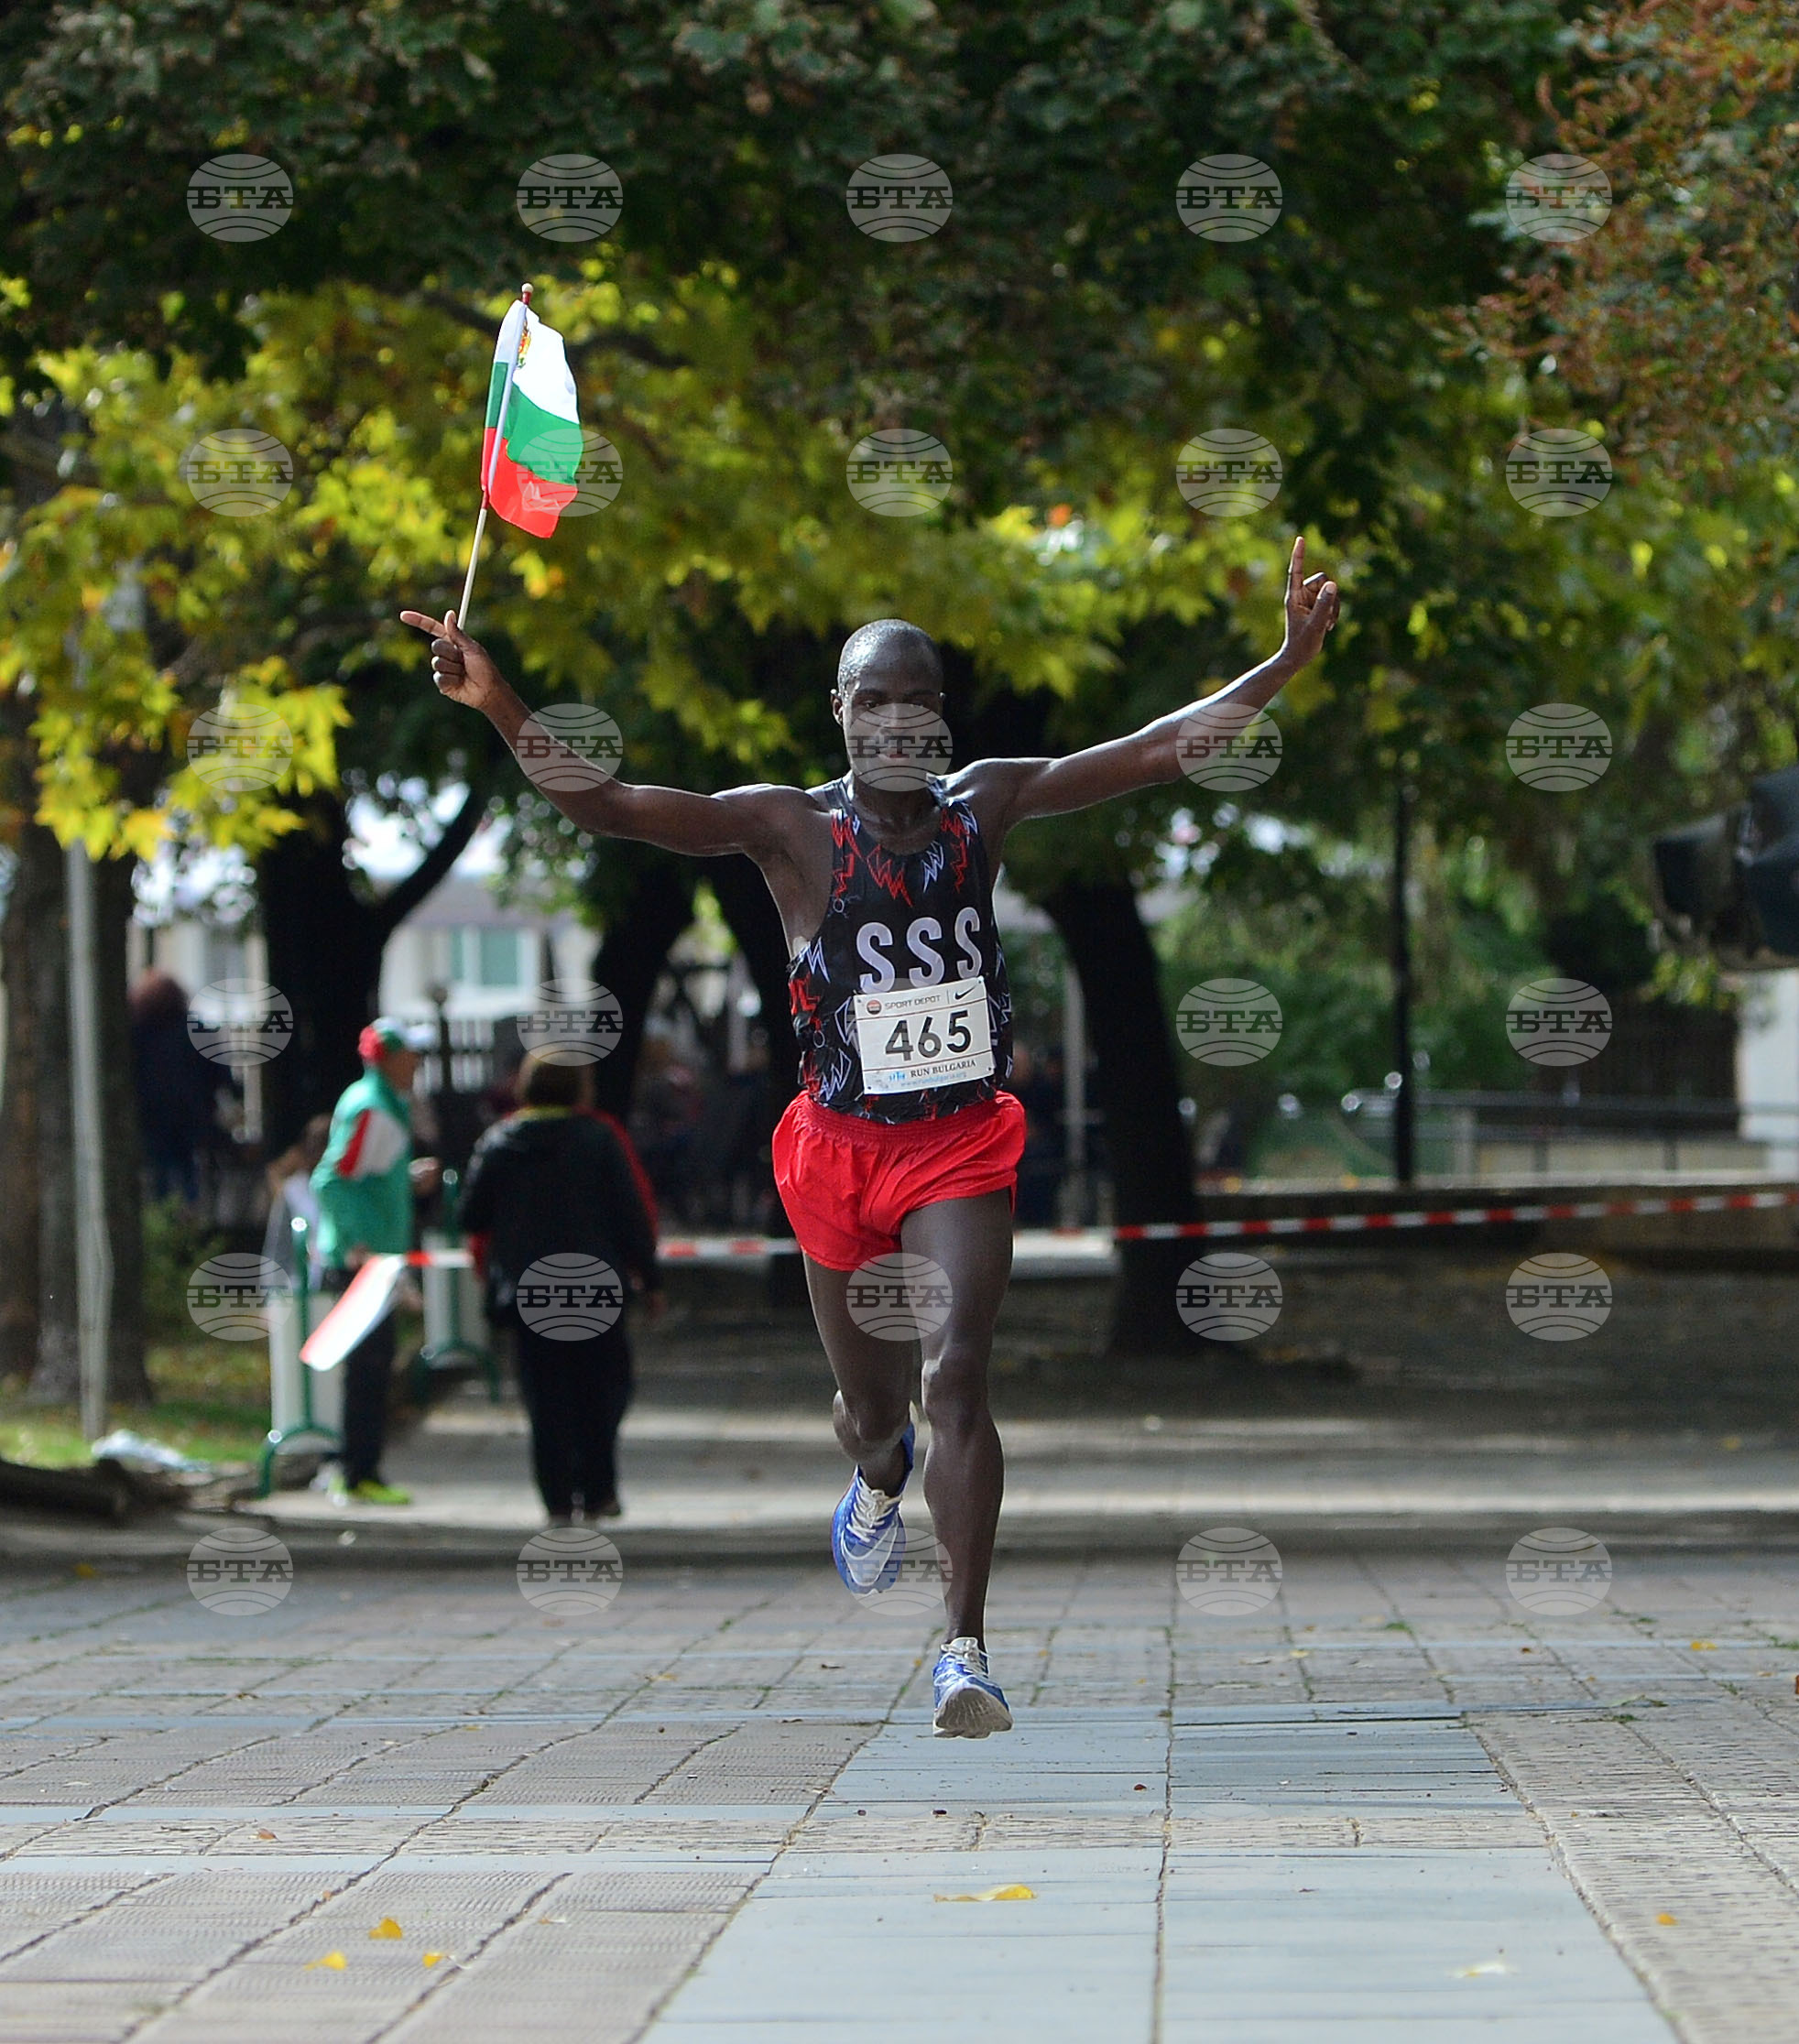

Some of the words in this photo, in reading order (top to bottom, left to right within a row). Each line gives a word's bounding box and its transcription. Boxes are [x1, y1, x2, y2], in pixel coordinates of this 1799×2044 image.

[856, 908, 983, 994] SSS
[885, 999, 912, 1010] SPORT
[914, 995, 941, 1006] DEPOT
[885, 1010, 971, 1061] 465
[910, 1069, 930, 1078] RUN
[932, 1060, 976, 1074] BULGARIA
